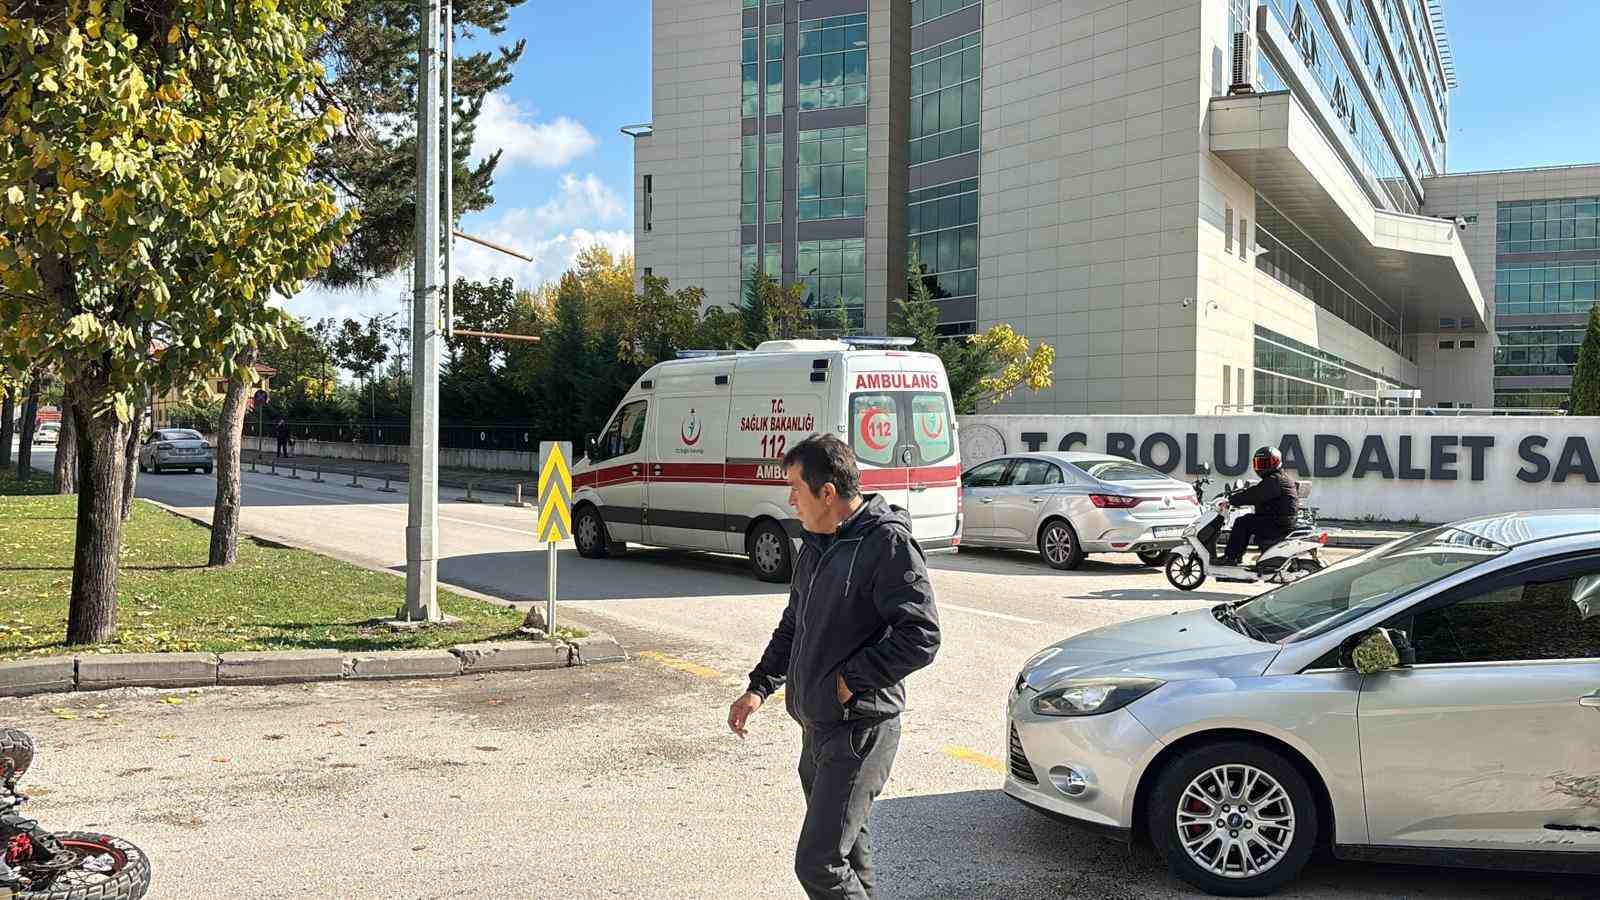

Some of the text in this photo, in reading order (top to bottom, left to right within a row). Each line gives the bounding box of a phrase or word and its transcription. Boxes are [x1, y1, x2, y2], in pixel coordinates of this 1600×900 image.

[856, 374, 938, 389] AMBULANS
[771, 399, 785, 413] T.C.
[740, 413, 814, 431] SAĞLIK BAKANLIĞI
[869, 422, 892, 437] 112
[761, 434, 785, 458] 112
[1106, 431, 1250, 476] BOLU
[1279, 434, 1495, 481] ADALET
[1516, 435, 1600, 483] SA
